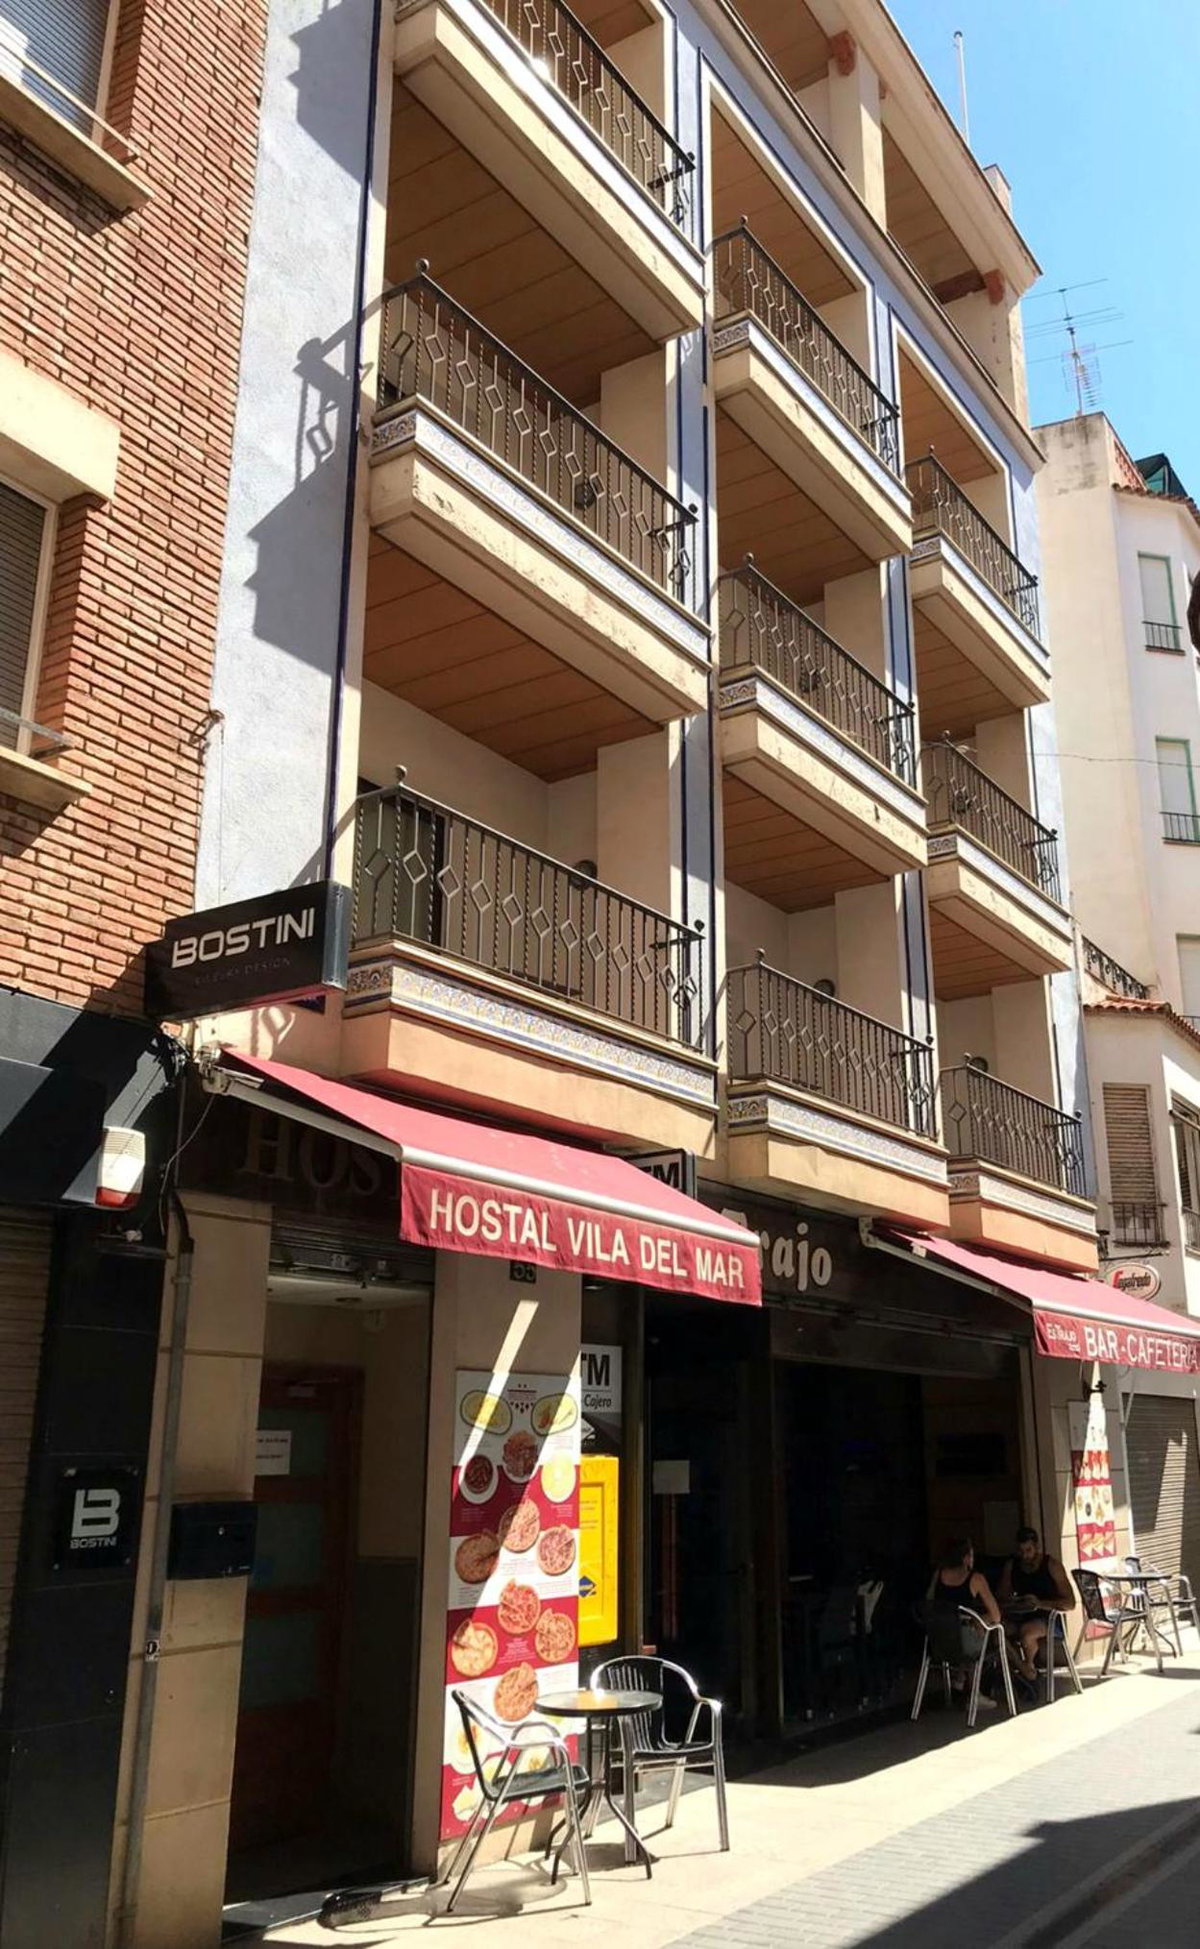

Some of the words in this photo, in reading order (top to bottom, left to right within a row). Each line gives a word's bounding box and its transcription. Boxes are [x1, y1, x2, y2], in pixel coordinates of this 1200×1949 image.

[172, 907, 315, 968] BOSTINI
[429, 1188, 557, 1251] HOSTAL
[567, 1218, 630, 1266] VILA
[639, 1235, 688, 1277] DEL
[696, 1247, 745, 1289] MAR
[721, 1208, 832, 1291] rajo
[72, 1489, 120, 1538] B
